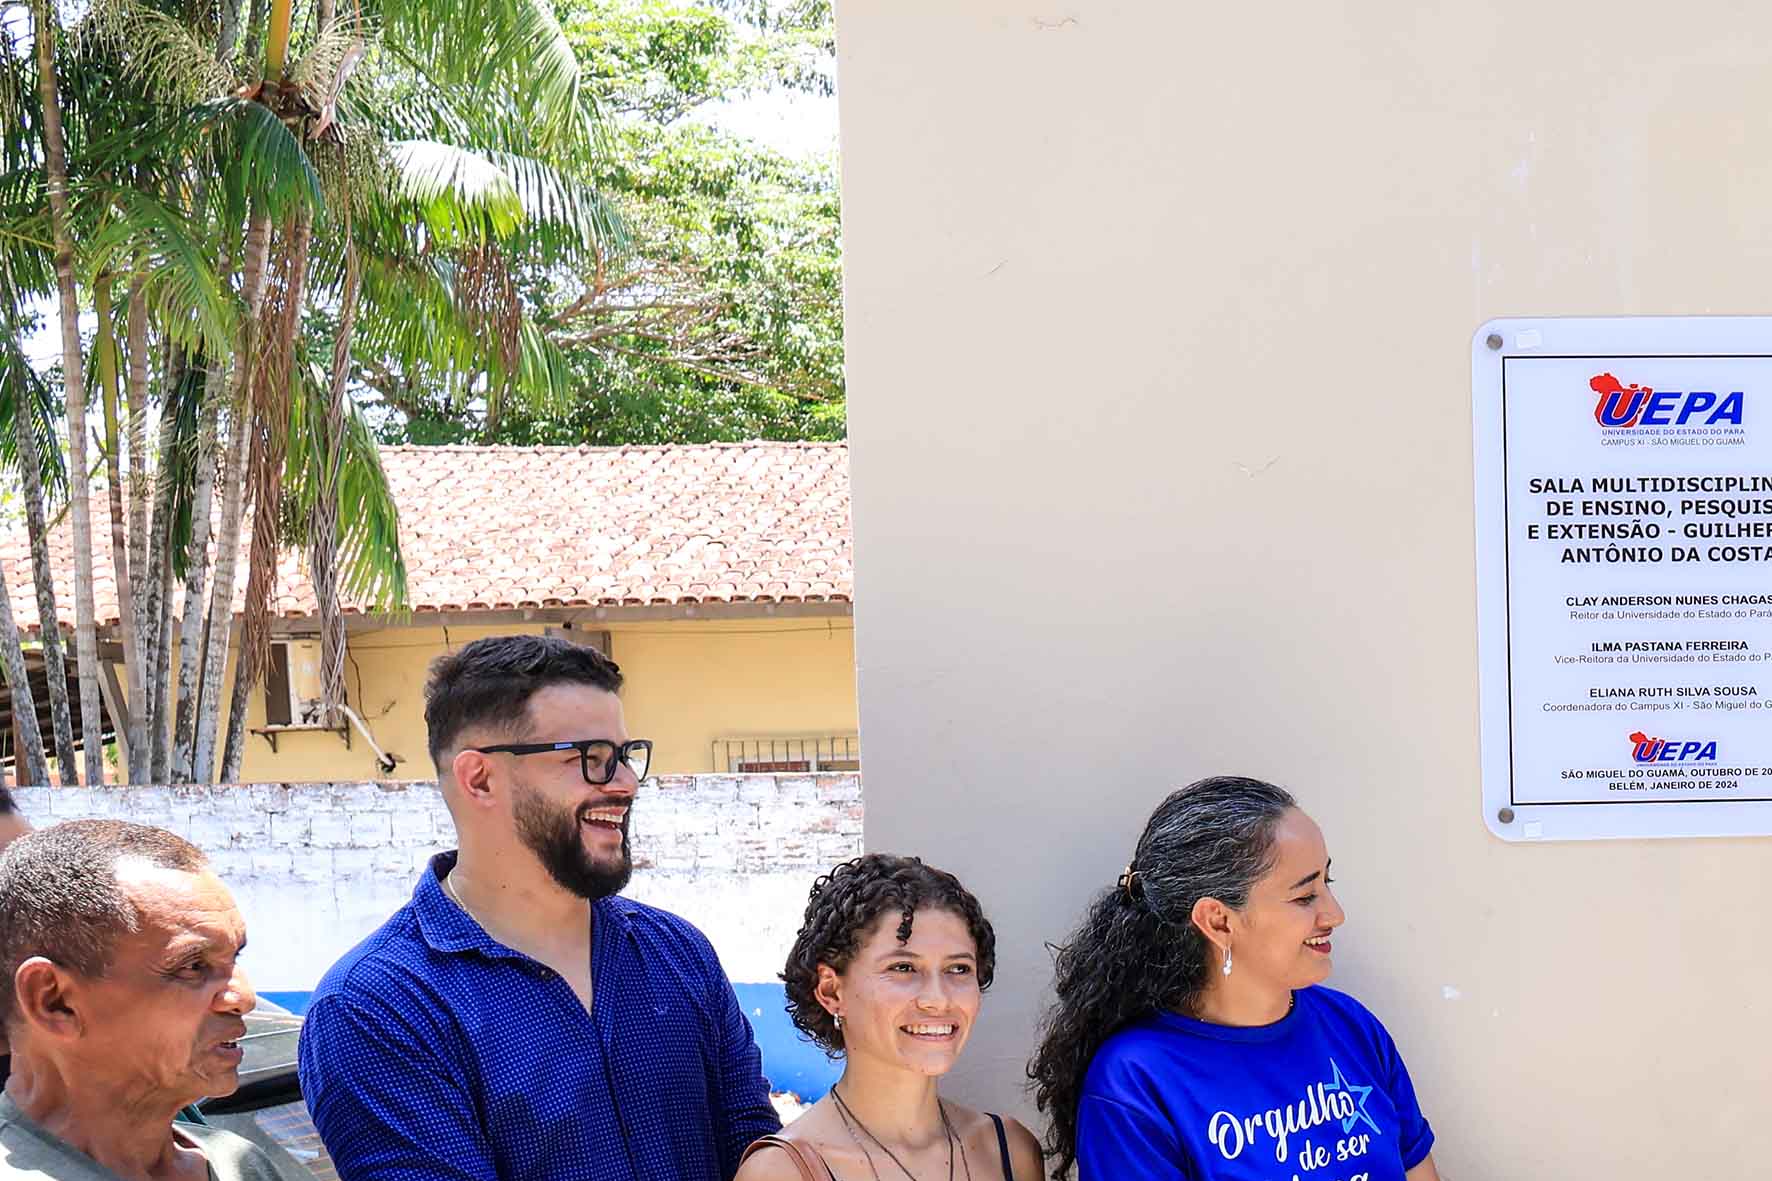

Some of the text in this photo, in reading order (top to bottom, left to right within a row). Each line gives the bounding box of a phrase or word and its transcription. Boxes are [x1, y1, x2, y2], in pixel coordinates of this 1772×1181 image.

[1600, 390, 1744, 426] UEPA
[1529, 478, 1584, 494] SALA
[1547, 501, 1574, 516] DE
[1582, 500, 1672, 521] ENSINO,
[1528, 525, 1539, 539] E
[1548, 519, 1660, 539] EXTENSÃO
[1561, 542, 1663, 563] ANTÔNIO
[1671, 547, 1701, 562] DA
[1566, 597, 1598, 606] CLAY
[1601, 596, 1672, 606] ANDERSON
[1676, 595, 1719, 605] NUNES
[1570, 609, 1772, 620] Reitor da Universidade do Estado do Pará
[1592, 641, 1749, 652] ILMA PASTANA FERREIRA
[1554, 655, 1614, 664] Vice-Reitora
[1616, 655, 1629, 663] da
[1632, 654, 1695, 663] Universidade
[1697, 654, 1710, 662] do
[1713, 653, 1747, 662] Estado
[1749, 653, 1761, 661] do
[1590, 686, 1757, 698] ELIANA RUTH SILVA SOUSA
[1542, 703, 1612, 712] Coordenadora
[1615, 703, 1629, 711] do
[1630, 702, 1671, 712] Campus
[1673, 701, 1683, 710] XI
[1693, 701, 1712, 710] São
[1715, 700, 1747, 711] Miguel
[1749, 700, 1762, 709] do
[1636, 740, 1717, 762] UEPA
[1561, 769, 1583, 779] SÃO
[1586, 770, 1626, 778] MIGUEL
[1628, 769, 1644, 778] DO
[1646, 767, 1688, 779] GUAMÁ,
[1690, 768, 1742, 777] OUTUBRO
[1745, 768, 1759, 776] DE
[1609, 780, 1738, 791] BELÉM, JANEIRO DE 2024
[1208, 1082, 1356, 1163] Orgulho
[1299, 1133, 1371, 1172] de ser
